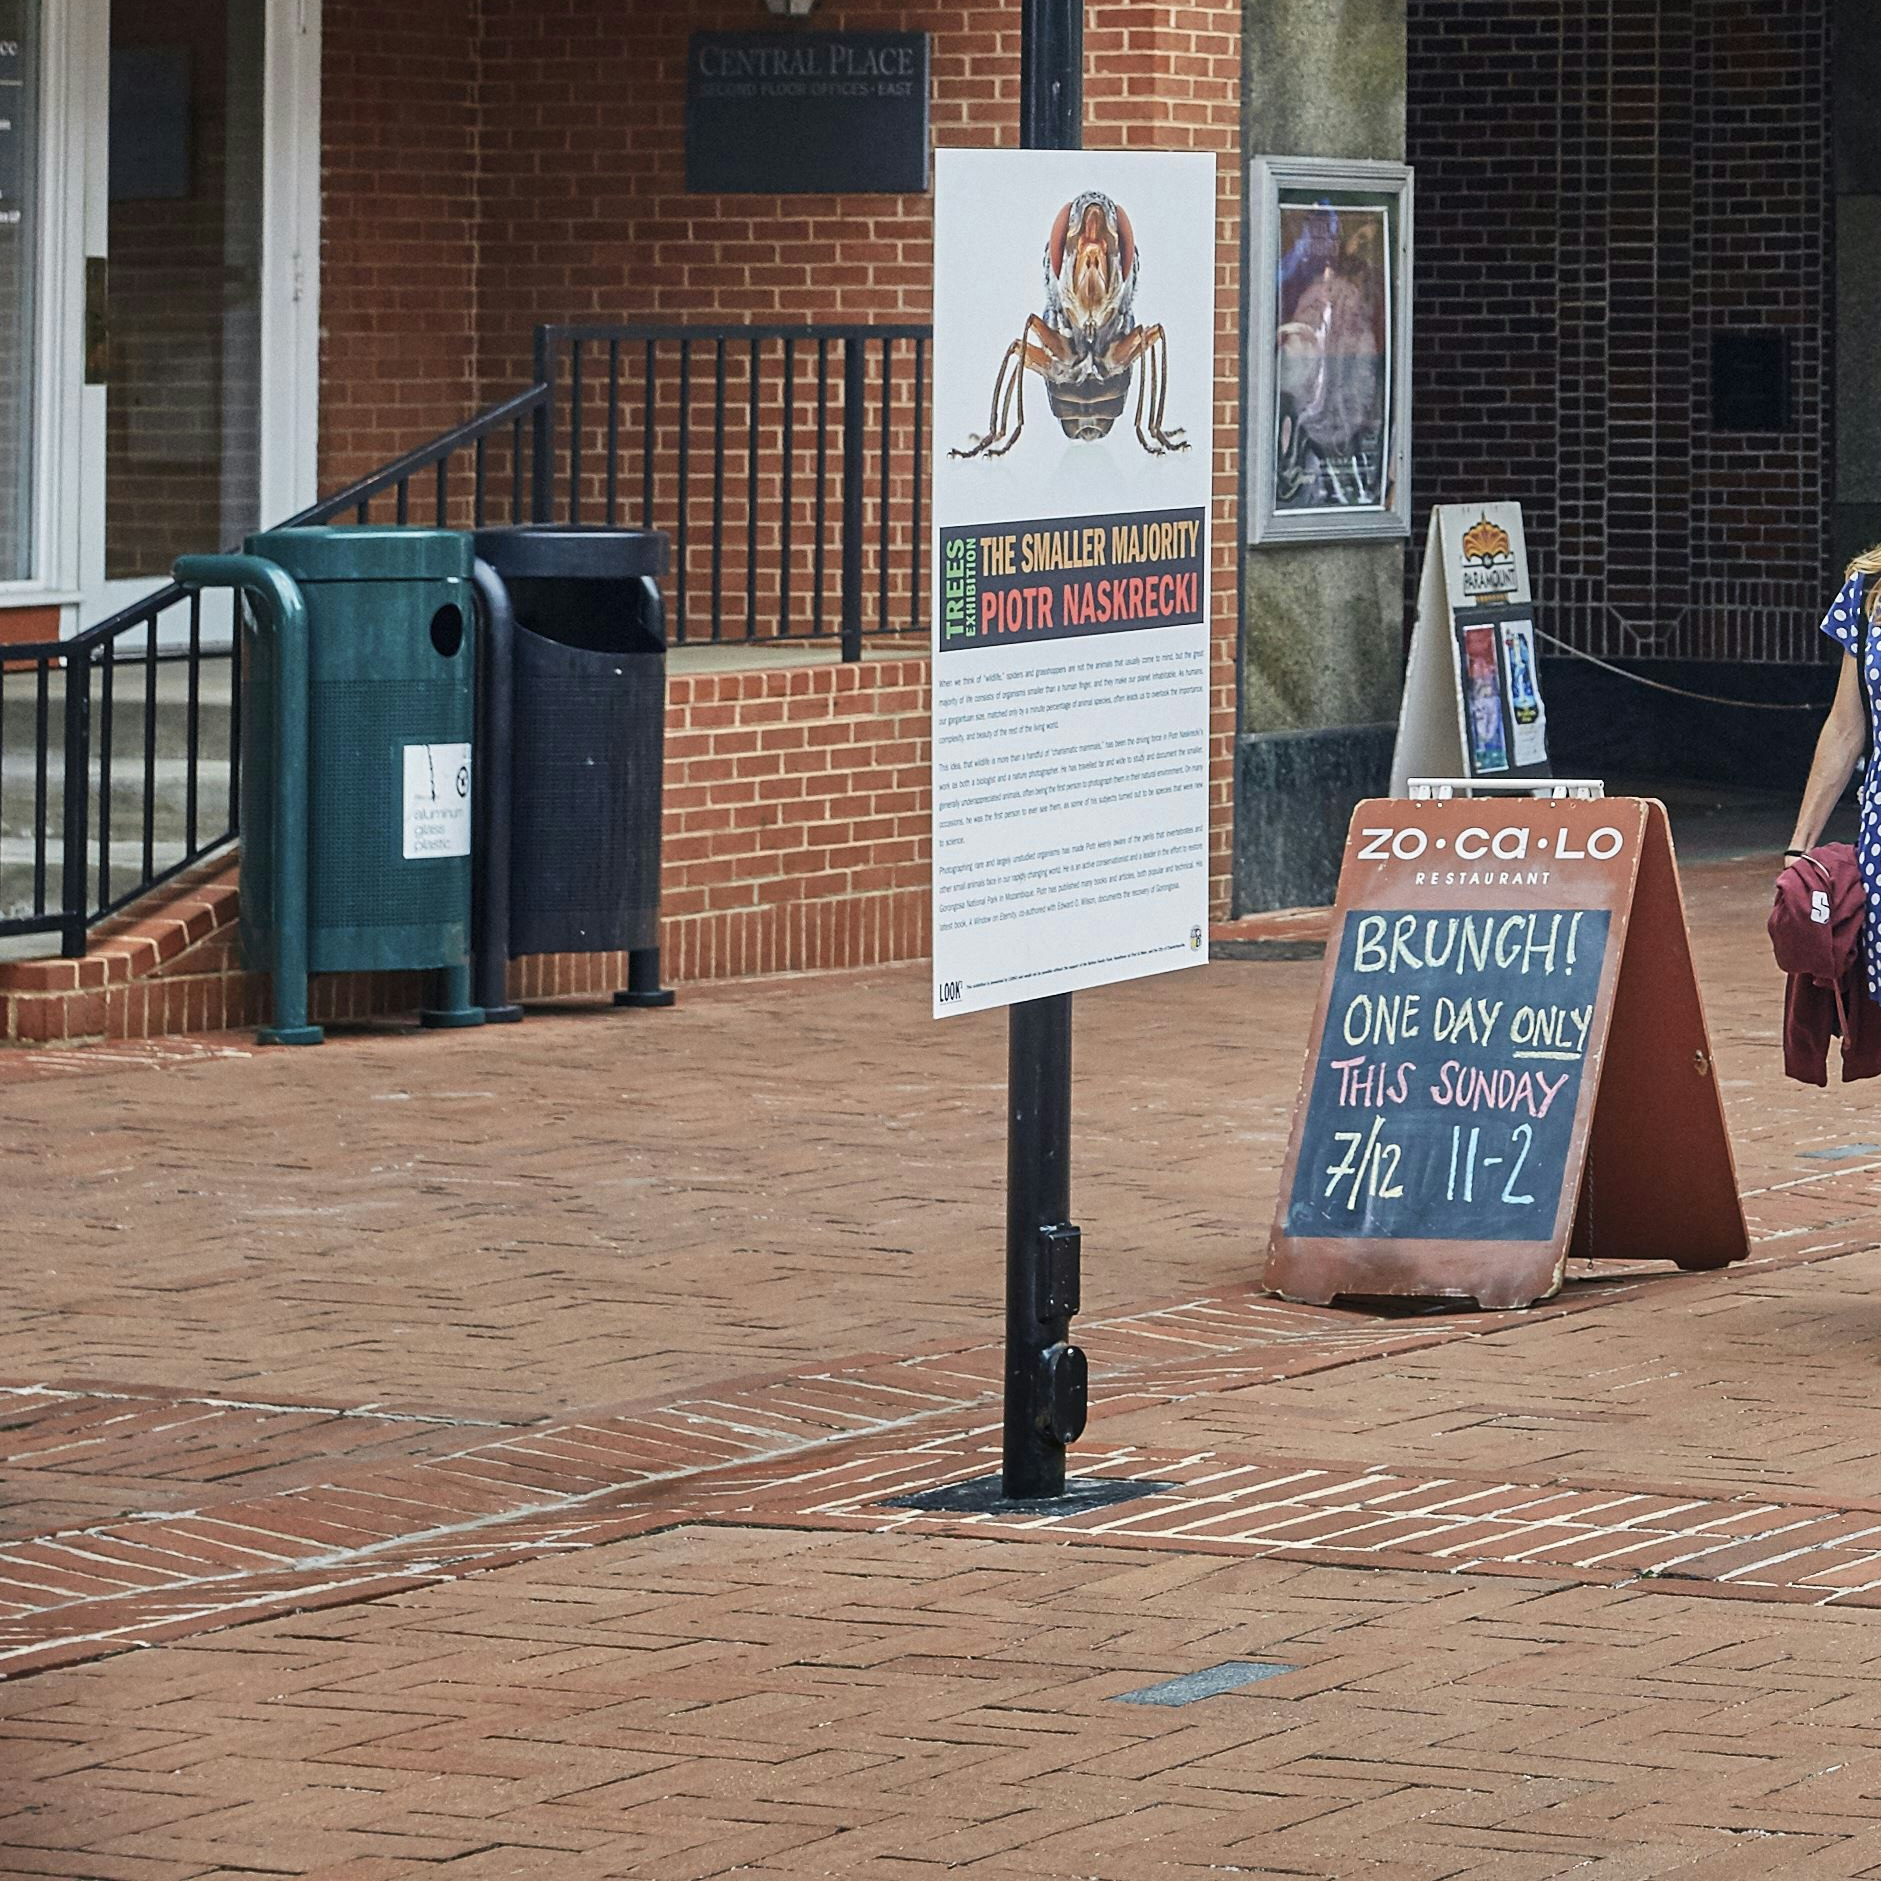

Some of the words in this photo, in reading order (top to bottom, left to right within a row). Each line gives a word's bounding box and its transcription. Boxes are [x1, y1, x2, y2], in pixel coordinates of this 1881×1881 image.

[699, 45, 822, 77] CENTRAL
[829, 44, 915, 76] PLACE
[980, 534, 1017, 577] THE
[1021, 527, 1106, 573] SMALLER
[1112, 520, 1200, 565] MAJORITY
[1464, 570, 1515, 589] PARAMOUNT
[945, 538, 965, 641] TREES
[965, 537, 977, 637] EXHIBITION
[981, 585, 1053, 635] PIOTR
[1063, 572, 1198, 627] NASKRECKI
[1415, 871, 1553, 888] RESTAURANT
[1354, 911, 1584, 977] BRUNCH!
[1342, 993, 1421, 1048] ONE
[1432, 997, 1505, 1047] DAY
[1510, 1003, 1594, 1053] ONLY
[1330, 1055, 1417, 1111] THIS
[1431, 1059, 1571, 1120] SUNDAY
[1323, 1115, 1405, 1211] 7/12
[1445, 1123, 1536, 1207] 11-2
